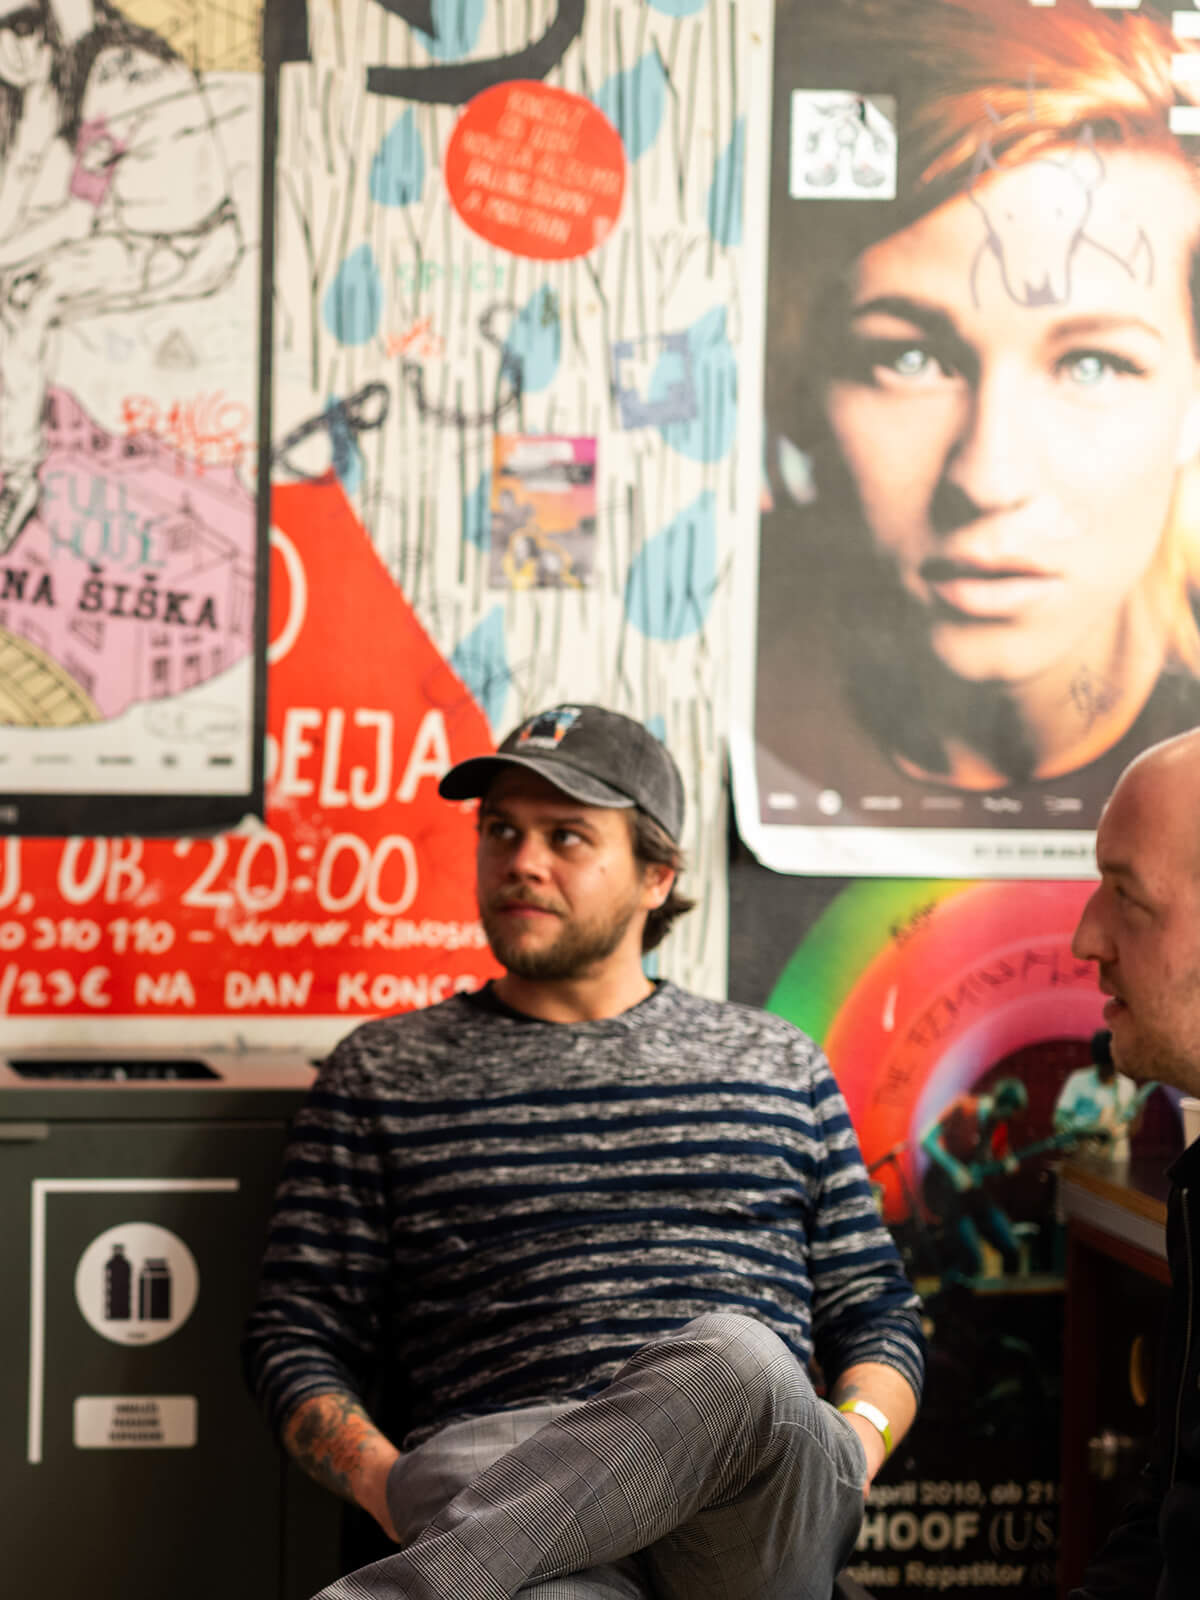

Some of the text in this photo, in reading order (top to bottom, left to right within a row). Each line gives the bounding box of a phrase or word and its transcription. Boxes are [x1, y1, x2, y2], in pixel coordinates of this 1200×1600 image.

[79, 564, 218, 630] ŠIŠKA
[267, 708, 456, 811] ELJA
[174, 833, 419, 916] 20:00
[32, 917, 102, 953] 310
[108, 917, 175, 955] 110
[134, 969, 196, 1008] NA
[223, 970, 315, 1010] DAN
[855, 1509, 1062, 1557] HOOF (US
[903, 1560, 1026, 1590] Repetitor
